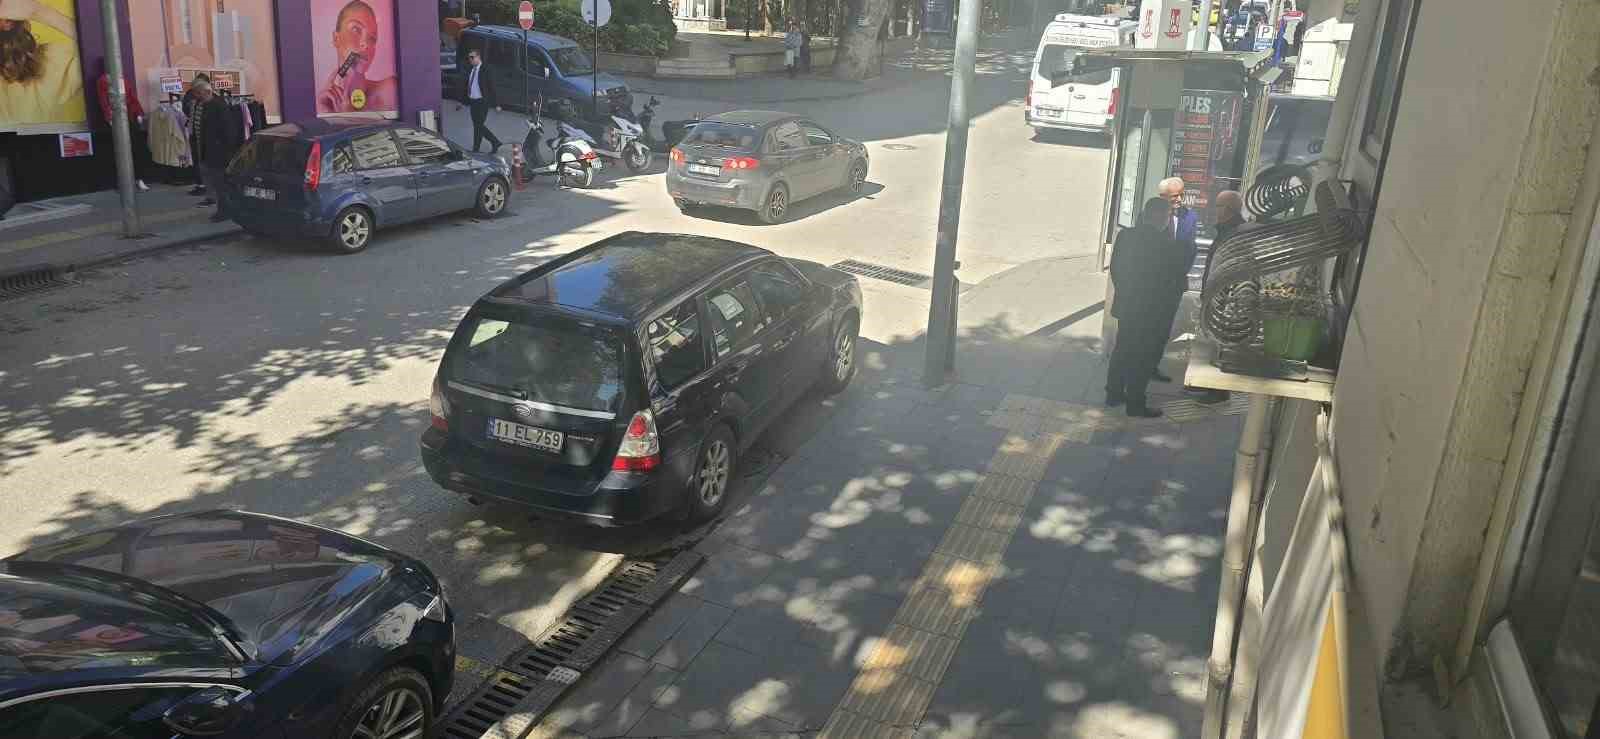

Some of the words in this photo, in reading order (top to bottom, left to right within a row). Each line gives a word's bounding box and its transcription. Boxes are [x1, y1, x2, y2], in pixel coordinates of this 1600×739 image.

[496, 421, 509, 436] 11
[514, 425, 532, 441] EL
[536, 429, 561, 447] 759
